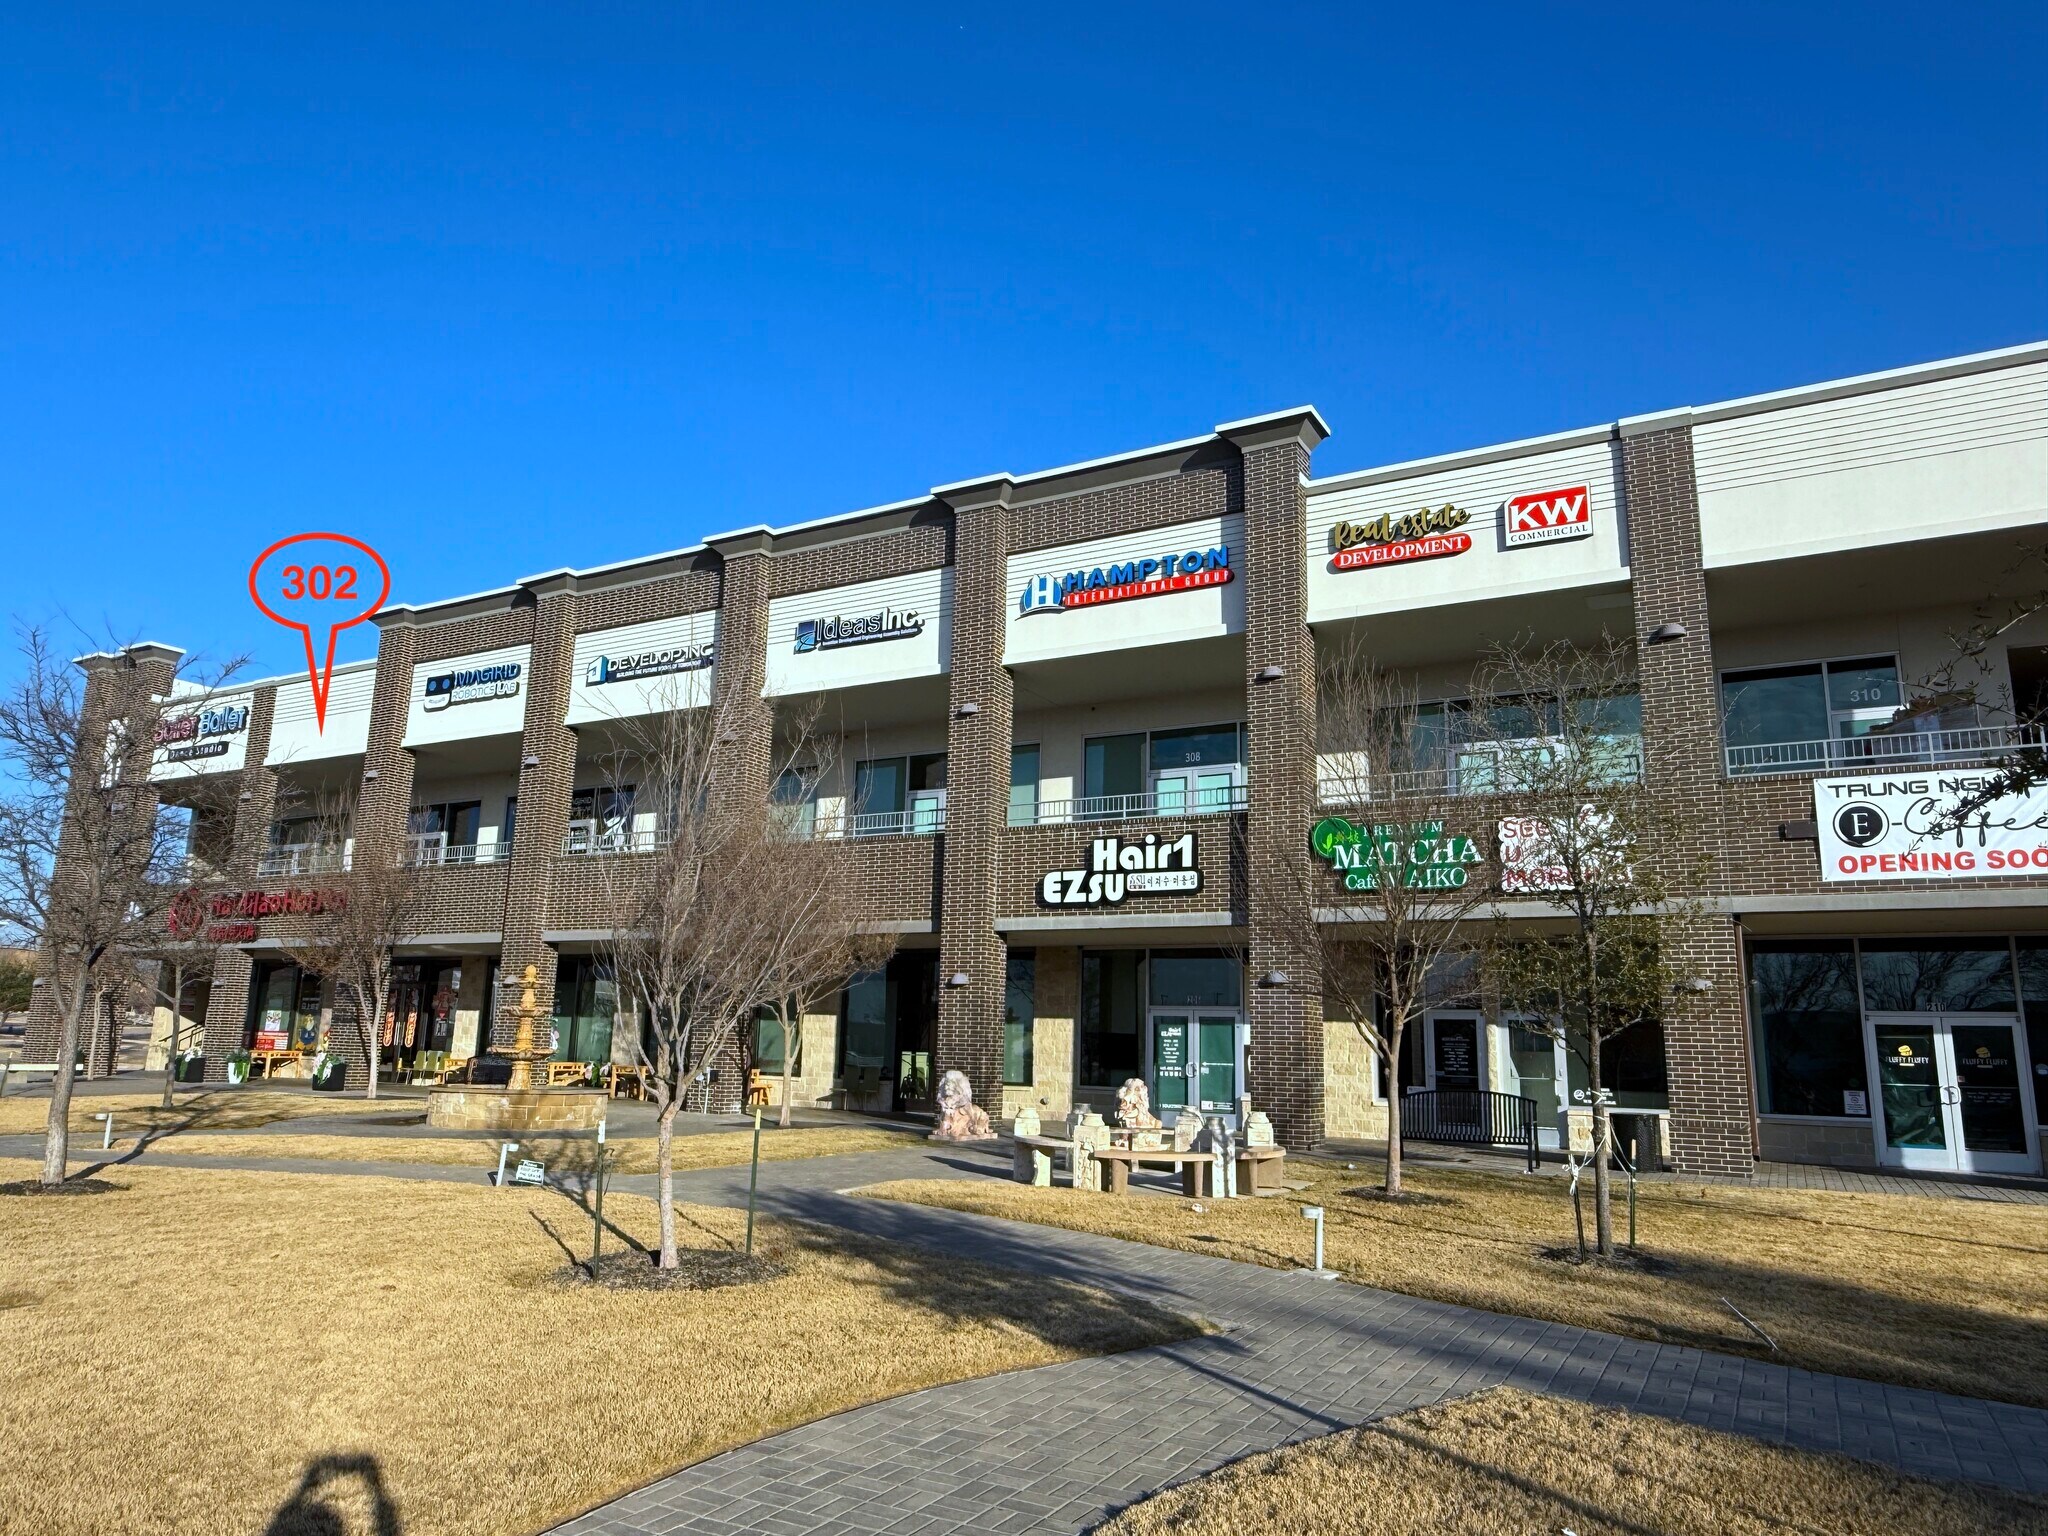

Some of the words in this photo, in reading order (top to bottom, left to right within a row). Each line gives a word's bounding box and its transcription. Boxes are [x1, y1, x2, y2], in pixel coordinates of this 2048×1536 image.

[1510, 493, 1586, 532] KW
[1334, 513, 1395, 549] Real
[1510, 525, 1588, 542] COMMERCIAL
[1340, 535, 1466, 567] DEVELOPMENT
[1065, 544, 1229, 592] HAMPTON
[1066, 579, 1174, 606] INTERNATIONAL
[1184, 571, 1229, 588] GROUP
[607, 644, 714, 672] DEVELOPING
[452, 685, 495, 700] ROBOTICS
[497, 681, 516, 693] LAB
[1850, 687, 1882, 702] 310
[200, 706, 246, 734] Ballet
[196, 744, 222, 755] Studio
[1185, 751, 1201, 763] 308
[1828, 780, 1929, 798] TRUNG
[1093, 834, 1193, 871] Hair1
[1333, 838, 1485, 870] MATCHA
[1838, 851, 1976, 874] OPENING
[1926, 1003, 1946, 1012] 210
